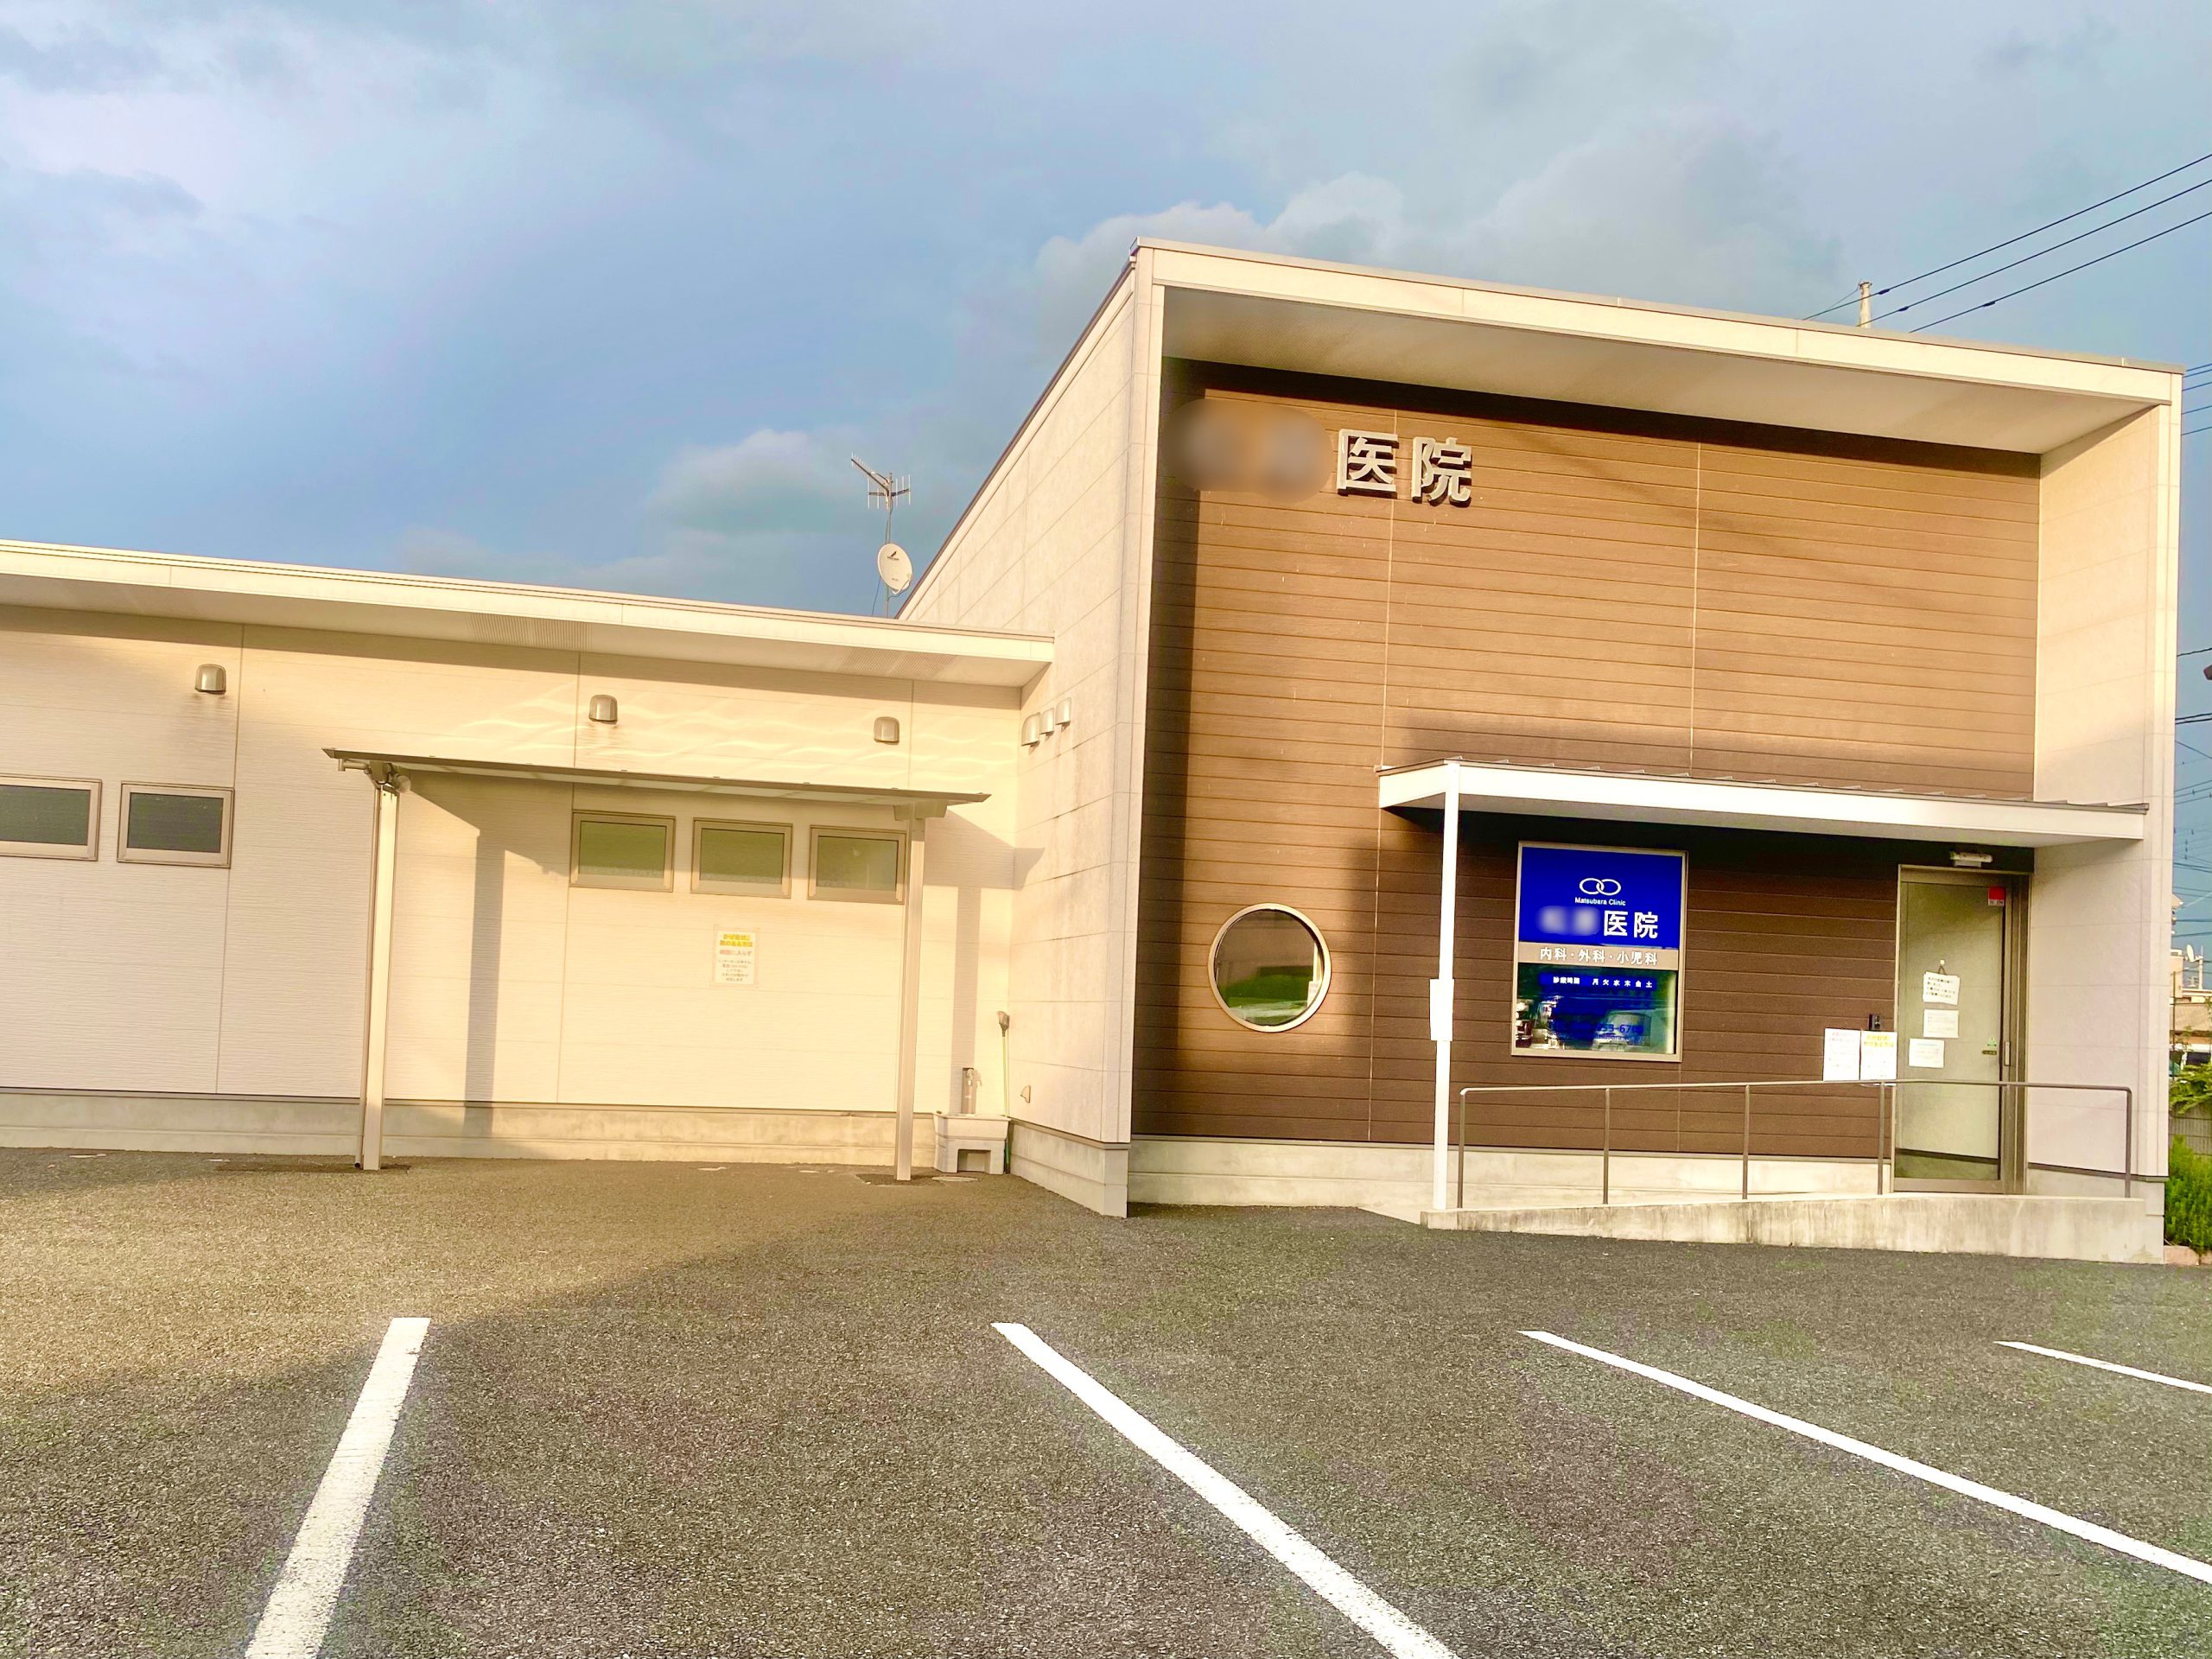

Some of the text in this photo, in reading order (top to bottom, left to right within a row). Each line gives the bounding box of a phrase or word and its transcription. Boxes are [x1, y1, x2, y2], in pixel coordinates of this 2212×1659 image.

[1337, 429, 1472, 507] 医院
[1574, 897, 1607, 906] Matsubara
[1603, 910, 1659, 939] 医院
